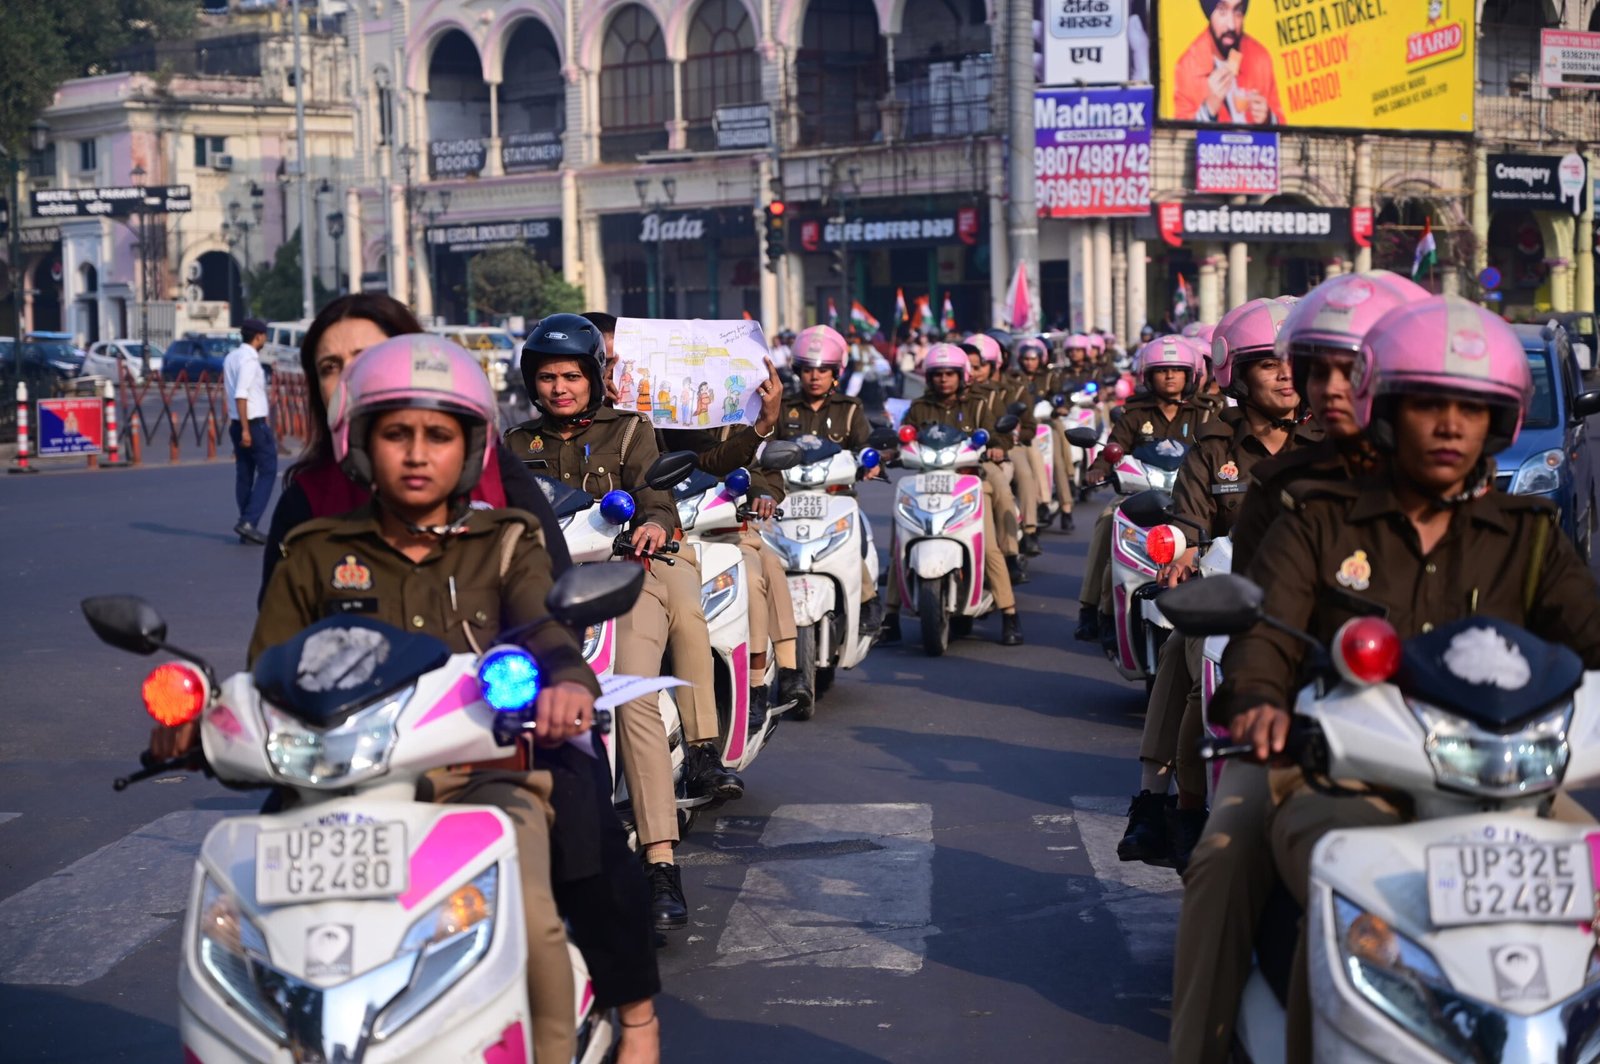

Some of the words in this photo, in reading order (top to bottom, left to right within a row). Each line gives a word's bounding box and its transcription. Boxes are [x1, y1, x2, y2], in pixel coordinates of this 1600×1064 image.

[1059, 15, 1113, 29] भास्कर
[1275, 11, 1317, 47] NEED
[1320, 6, 1331, 34] A
[1069, 46, 1103, 64] एप
[1280, 49, 1302, 79] TO
[1304, 32, 1349, 73] ENJOY
[1408, 26, 1461, 58] MARIO
[1286, 71, 1342, 113] MARIO!
[1034, 96, 1146, 128] Madmax
[431, 139, 483, 156] SCHOOL
[435, 154, 480, 171] BOOKS
[503, 144, 562, 162] STATIONERY
[1034, 143, 1150, 176] 9807498742
[1034, 176, 1150, 209] 9696979262
[638, 214, 705, 242] Bata
[790, 495, 822, 506] UP32E
[791, 506, 823, 517] G2507
[286, 827, 389, 860] UP32E
[287, 860, 391, 894] G2480
[1459, 847, 1574, 878] UP32E
[1463, 883, 1575, 916] G2487
